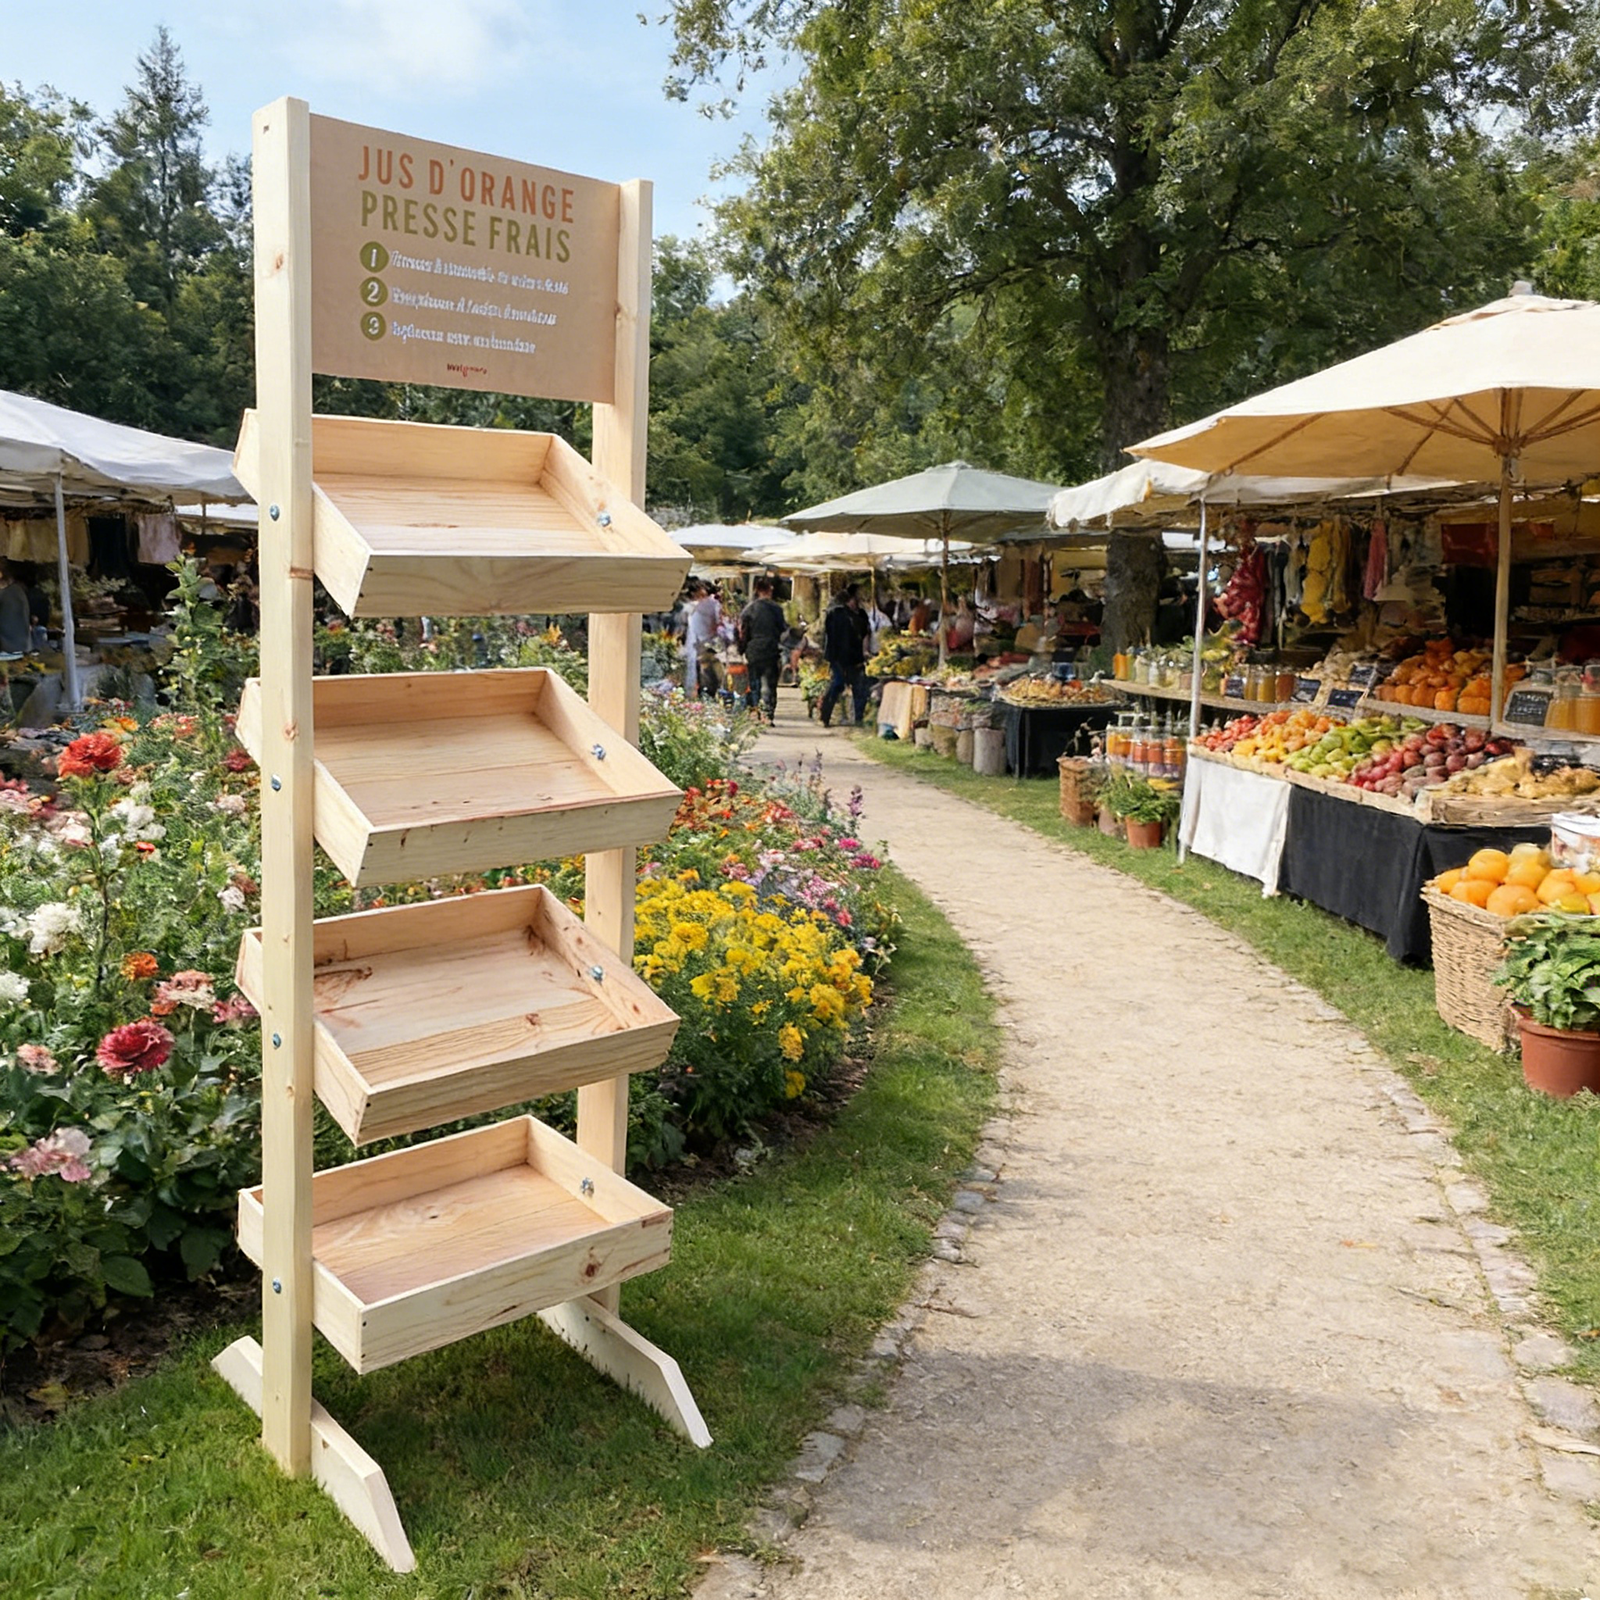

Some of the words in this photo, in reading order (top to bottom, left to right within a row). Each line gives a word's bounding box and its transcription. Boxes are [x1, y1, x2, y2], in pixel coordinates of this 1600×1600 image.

[358, 146, 413, 188] JUS
[429, 159, 573, 223] D'ORANGE
[361, 190, 476, 246] PRESSE
[489, 216, 570, 263] FRAIS
[367, 281, 380, 302] 2
[368, 317, 379, 335] 3
